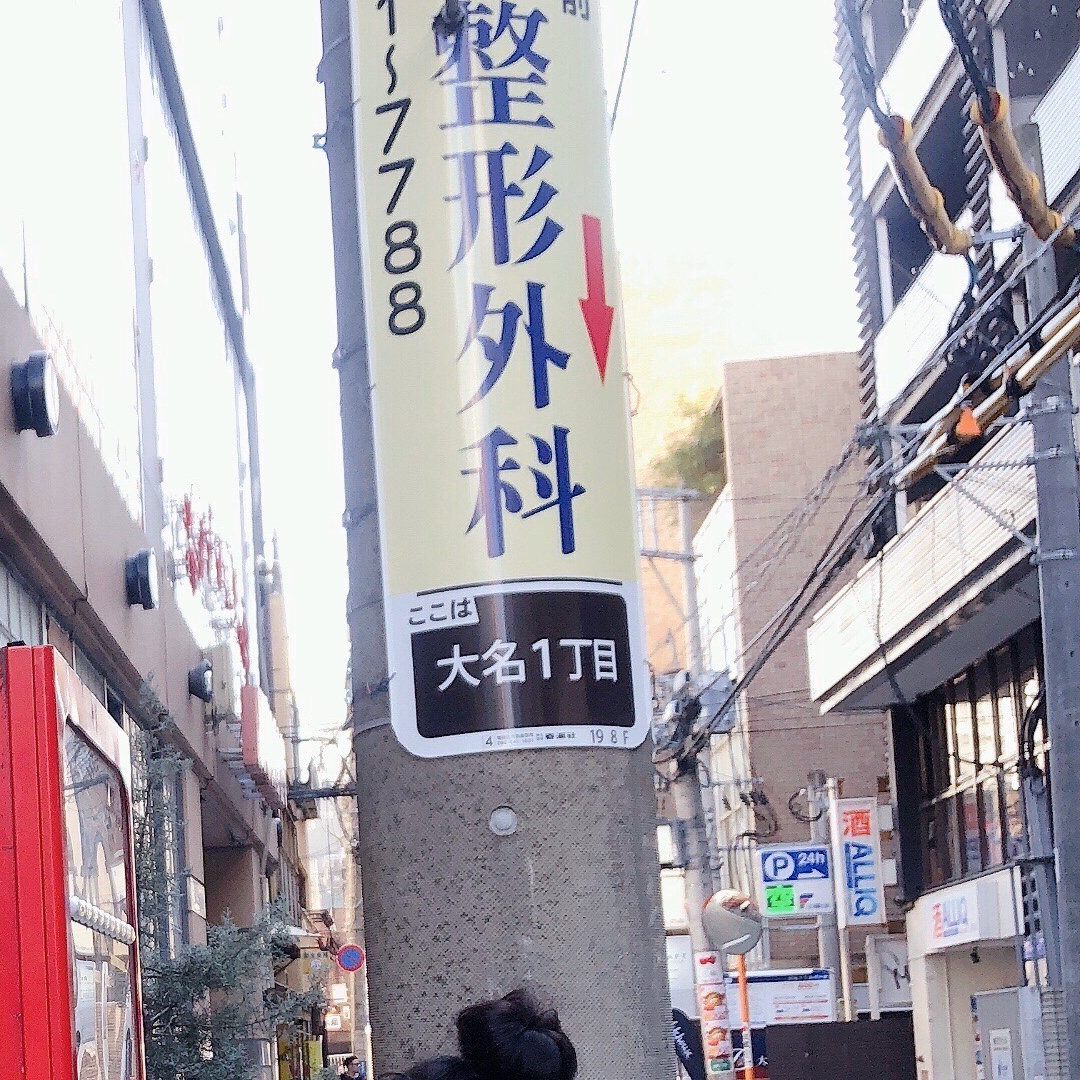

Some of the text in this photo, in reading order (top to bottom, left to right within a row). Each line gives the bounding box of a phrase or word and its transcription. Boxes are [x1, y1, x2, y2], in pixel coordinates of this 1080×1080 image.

[408, 597, 473, 626] ここは
[436, 638, 619, 693] 大名1丁目
[843, 809, 871, 838] 酒
[851, 842, 878, 917] ALLIQ
